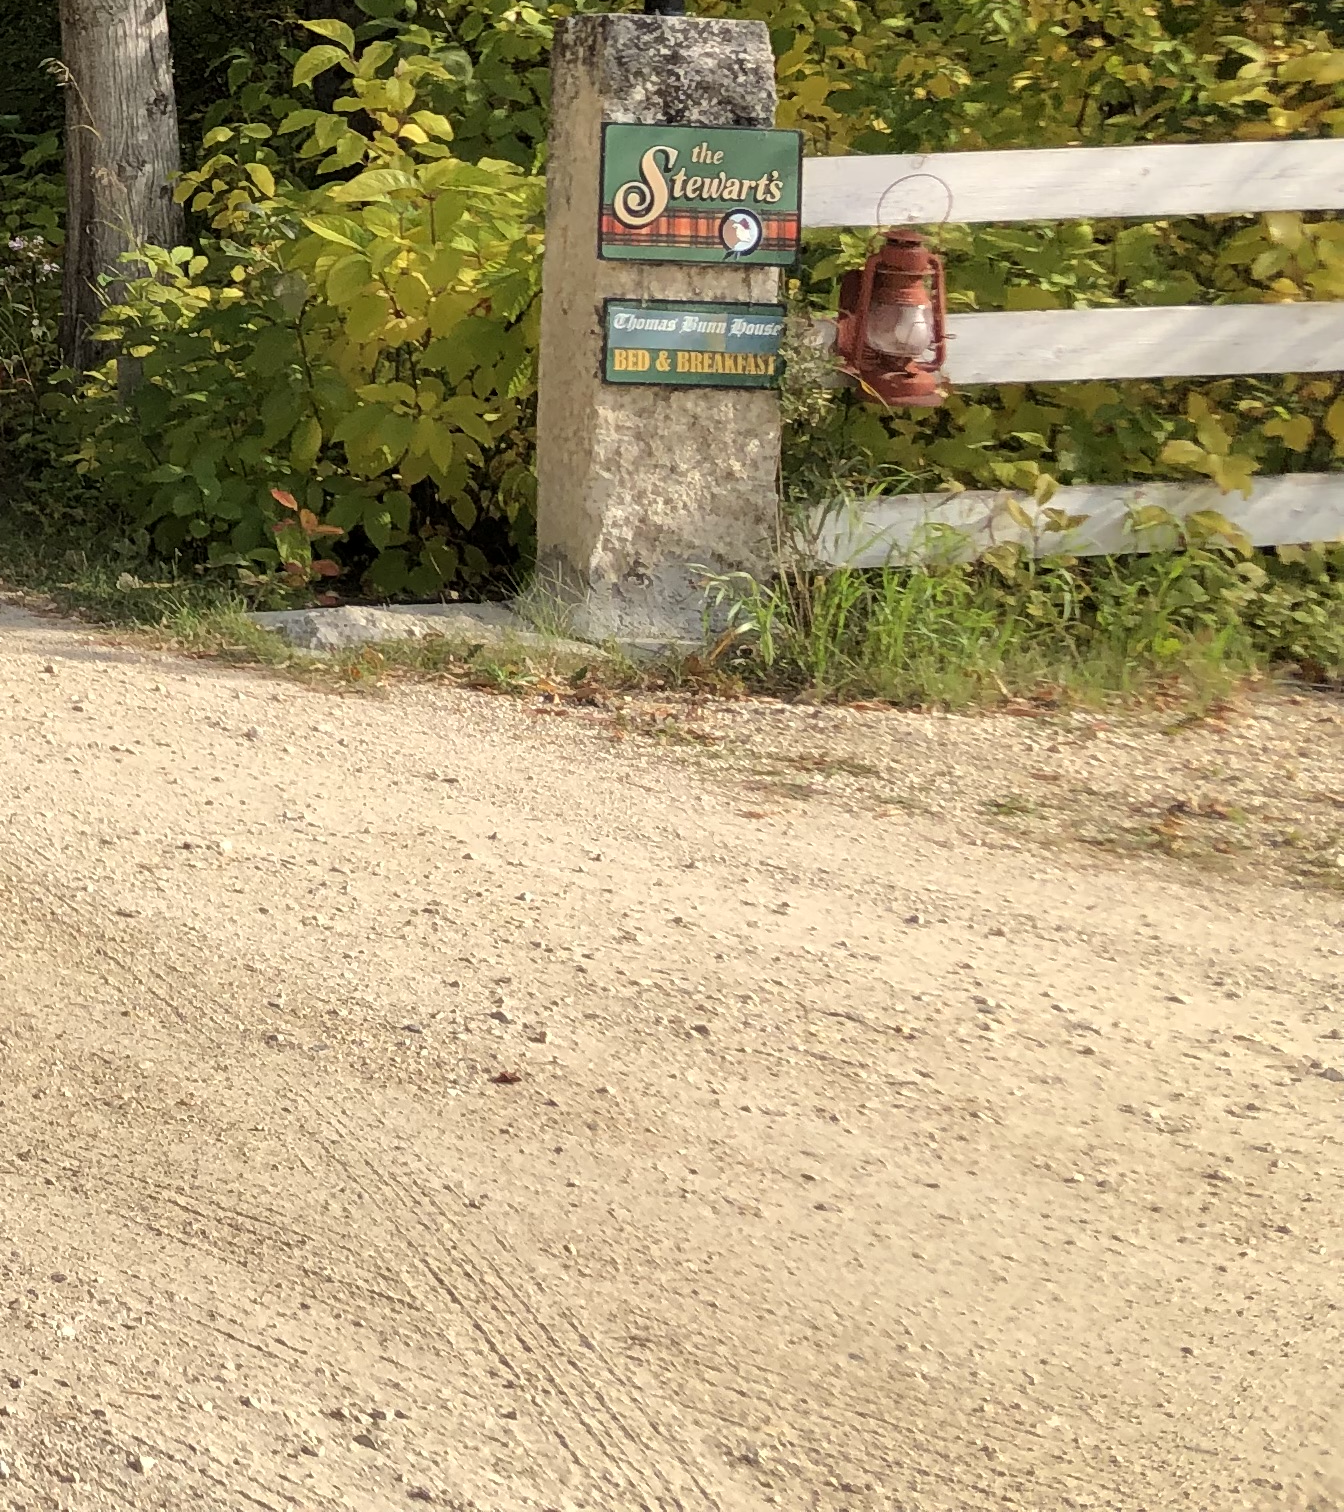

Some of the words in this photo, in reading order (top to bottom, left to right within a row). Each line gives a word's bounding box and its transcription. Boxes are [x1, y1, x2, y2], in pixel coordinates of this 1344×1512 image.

[691, 142, 724, 165] the
[613, 145, 784, 226] Stewart's
[613, 313, 677, 332] Thomas
[729, 318, 782, 336] House
[613, 349, 650, 372] BED
[655, 351, 672, 372] &
[675, 351, 777, 376] BREAKFAST
